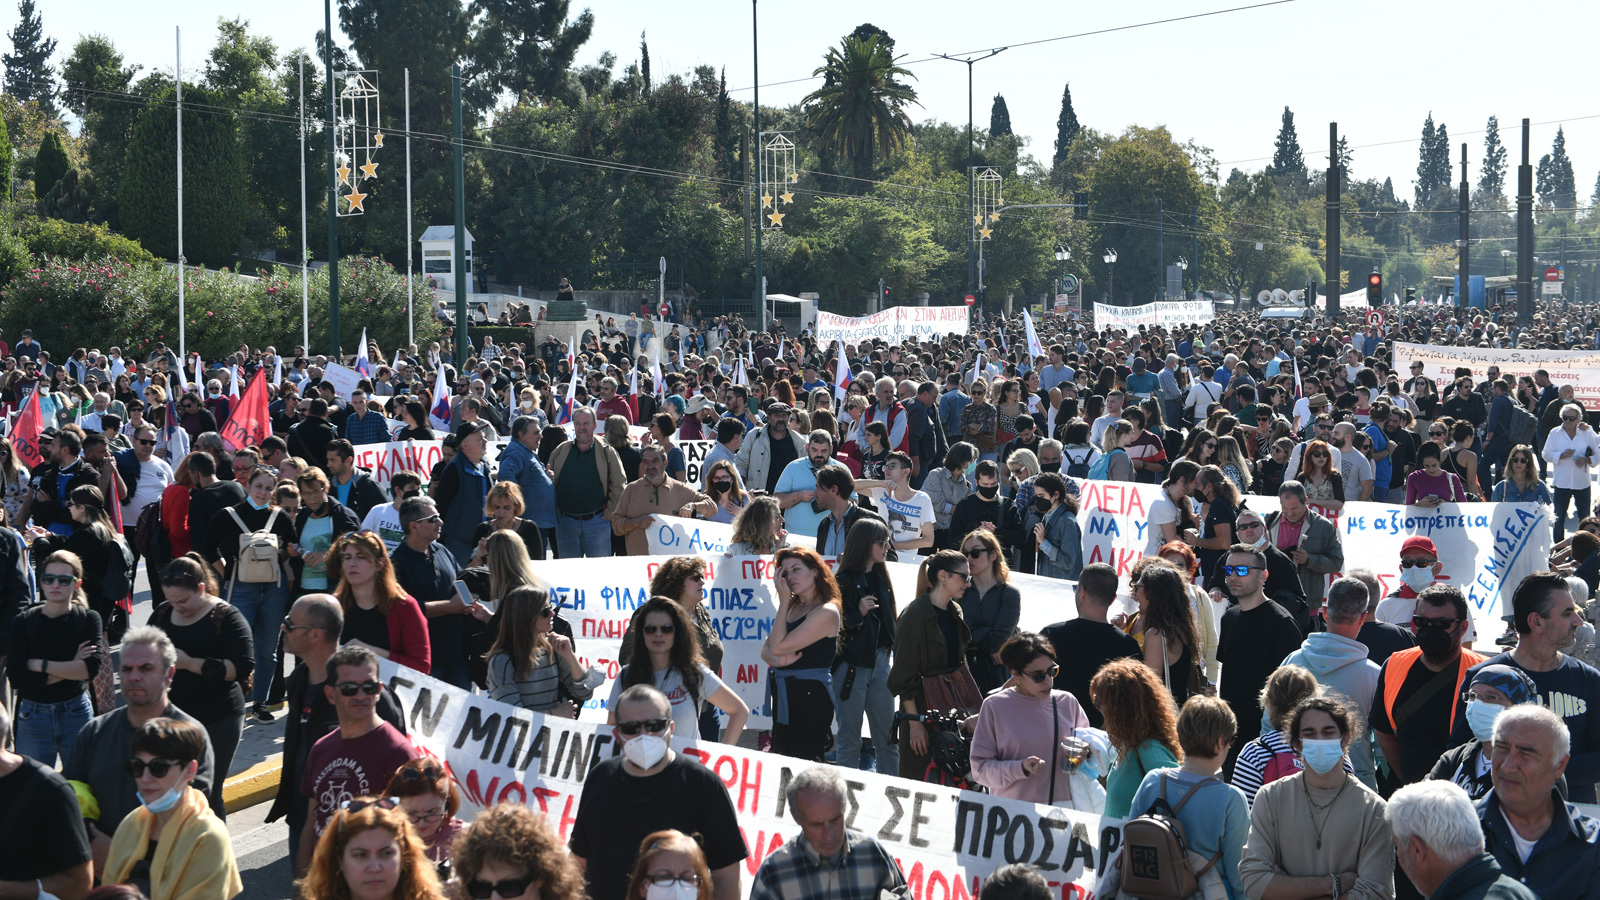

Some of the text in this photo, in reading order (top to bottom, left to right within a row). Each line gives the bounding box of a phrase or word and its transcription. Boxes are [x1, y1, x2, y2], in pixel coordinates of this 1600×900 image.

[914, 307, 937, 321] ΣΤΗΝ
[1347, 516, 1366, 534] με
[1374, 507, 1489, 537] αξιοπρέπεια
[659, 525, 680, 546] Οι
[877, 785, 938, 847] ΣΕ
